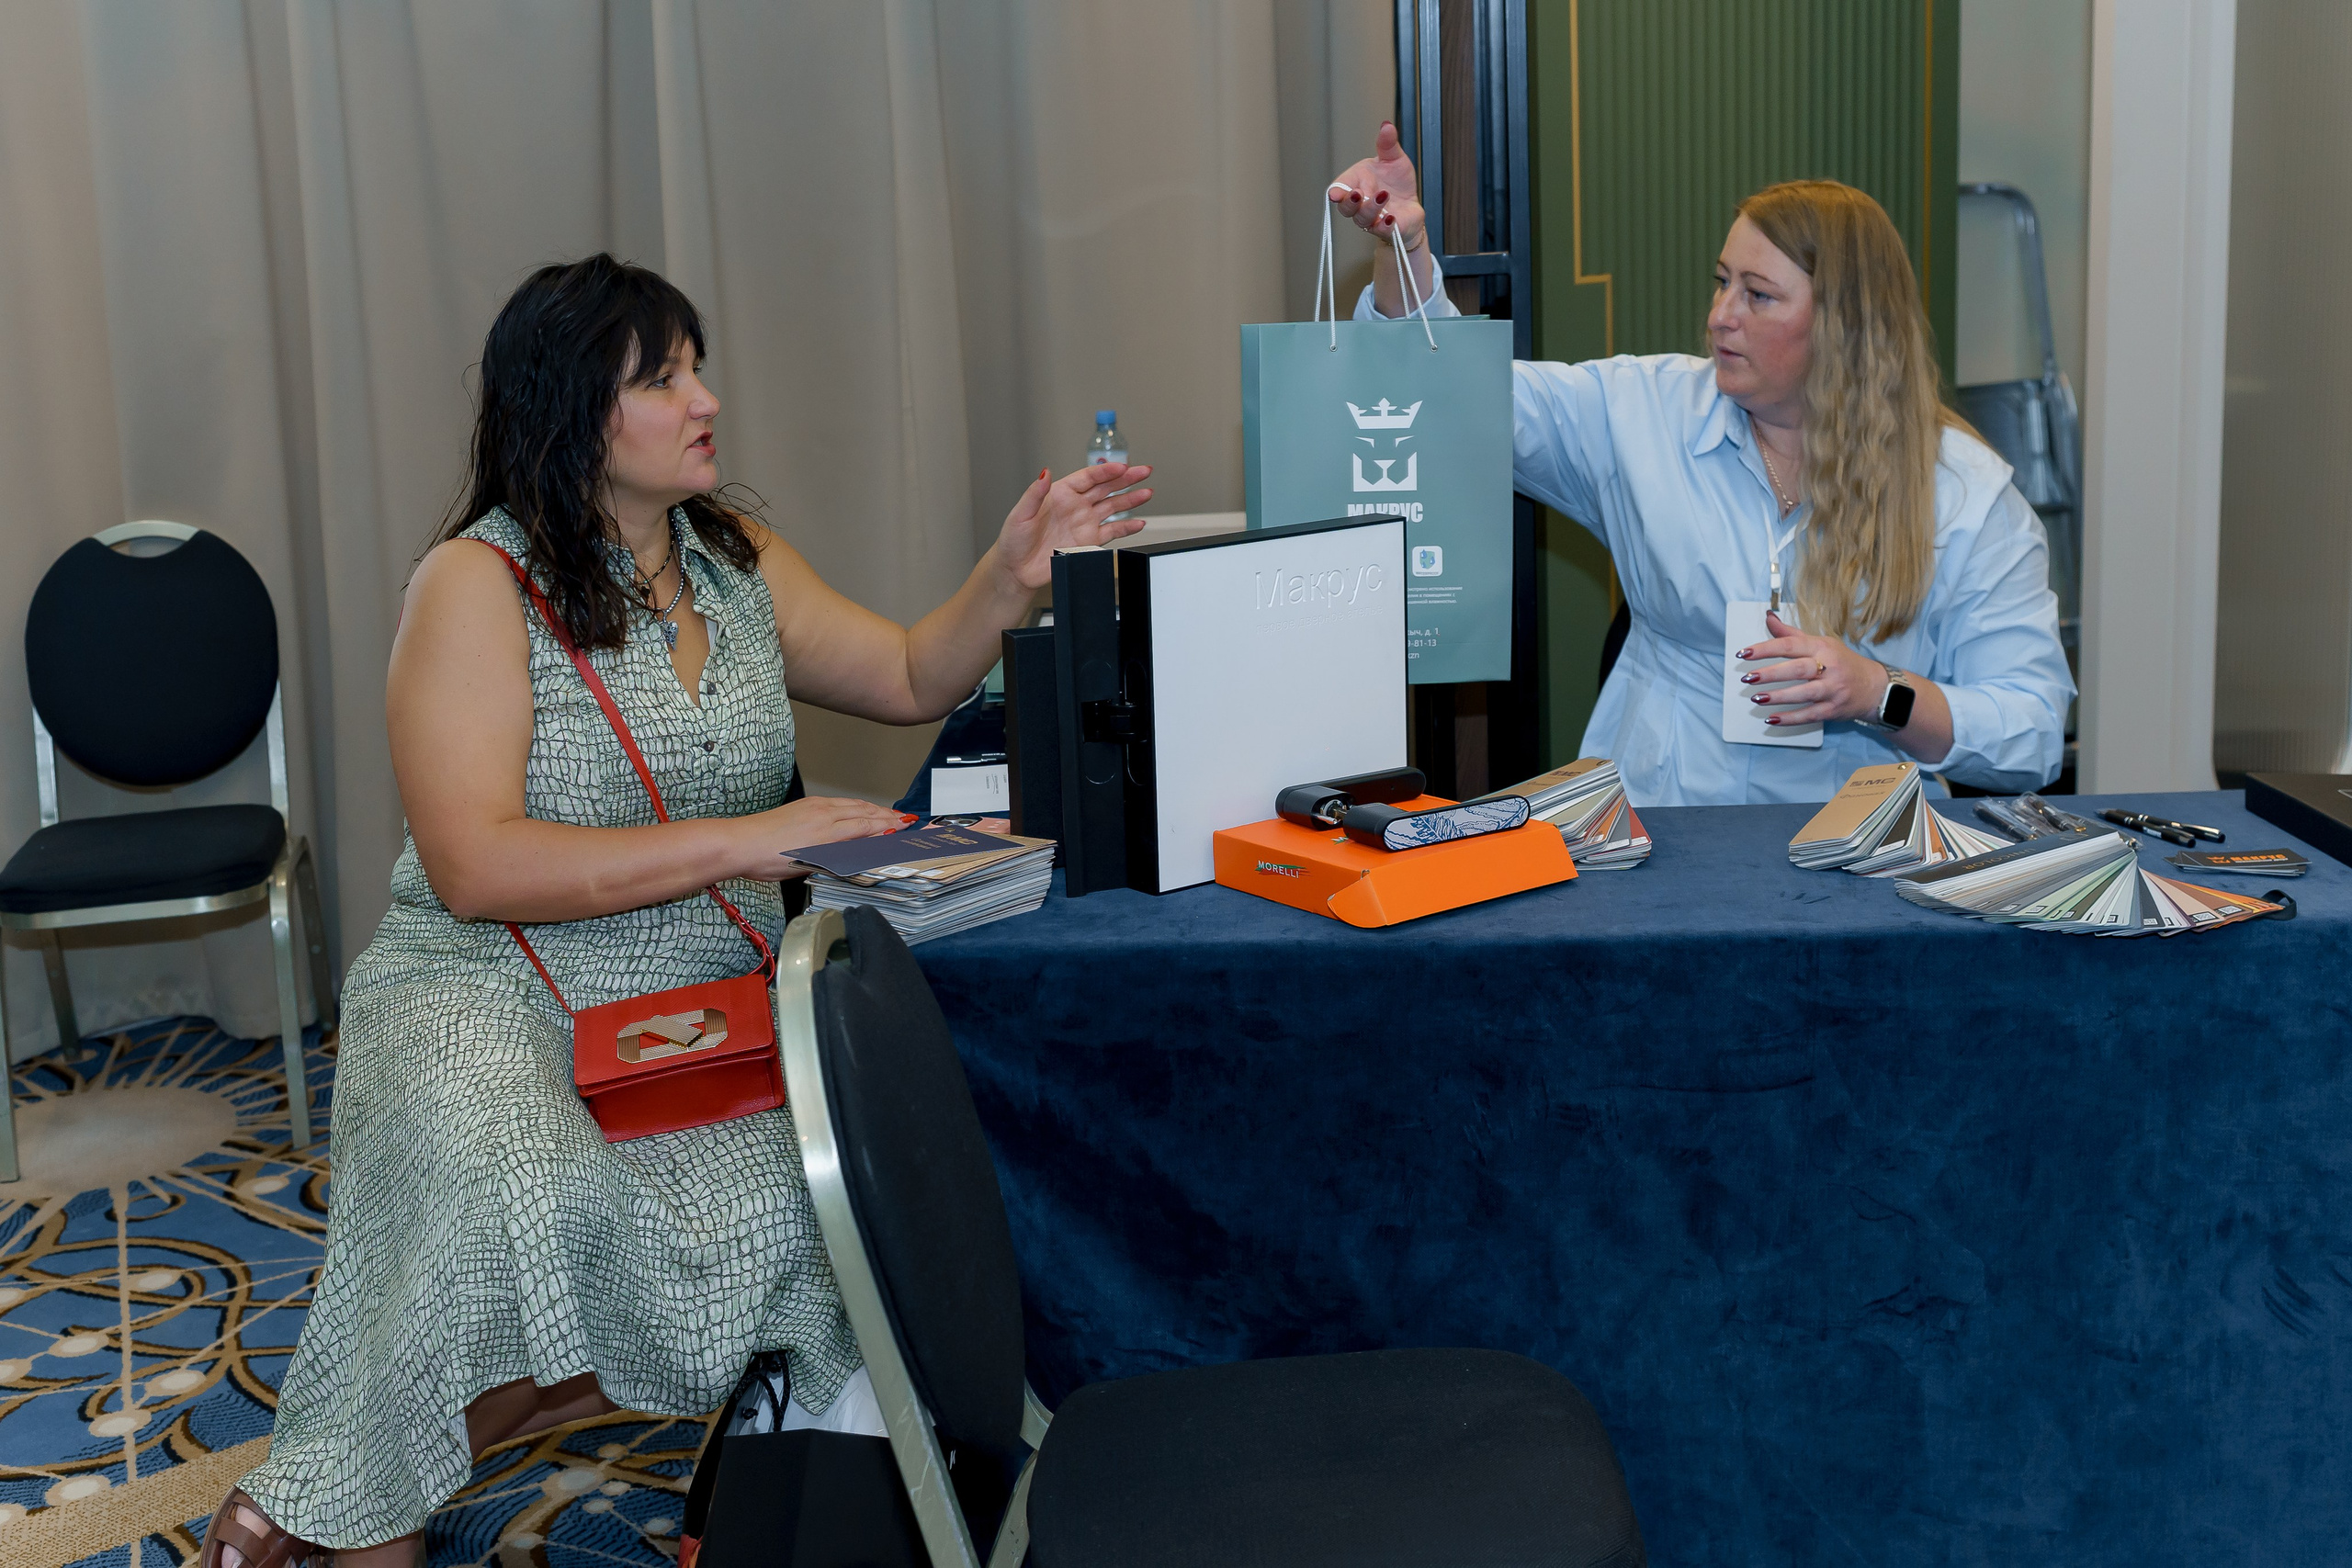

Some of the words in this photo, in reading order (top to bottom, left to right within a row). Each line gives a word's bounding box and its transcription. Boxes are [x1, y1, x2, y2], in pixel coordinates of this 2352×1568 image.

[1255, 563, 1383, 610] Макрус
[1256, 619, 1295, 636] первое
[1297, 612, 1344, 630] дверное
[1347, 604, 1383, 620] ателье
[1258, 860, 1299, 878] MORELLI
[1962, 848, 2036, 870] UNICOLOR
